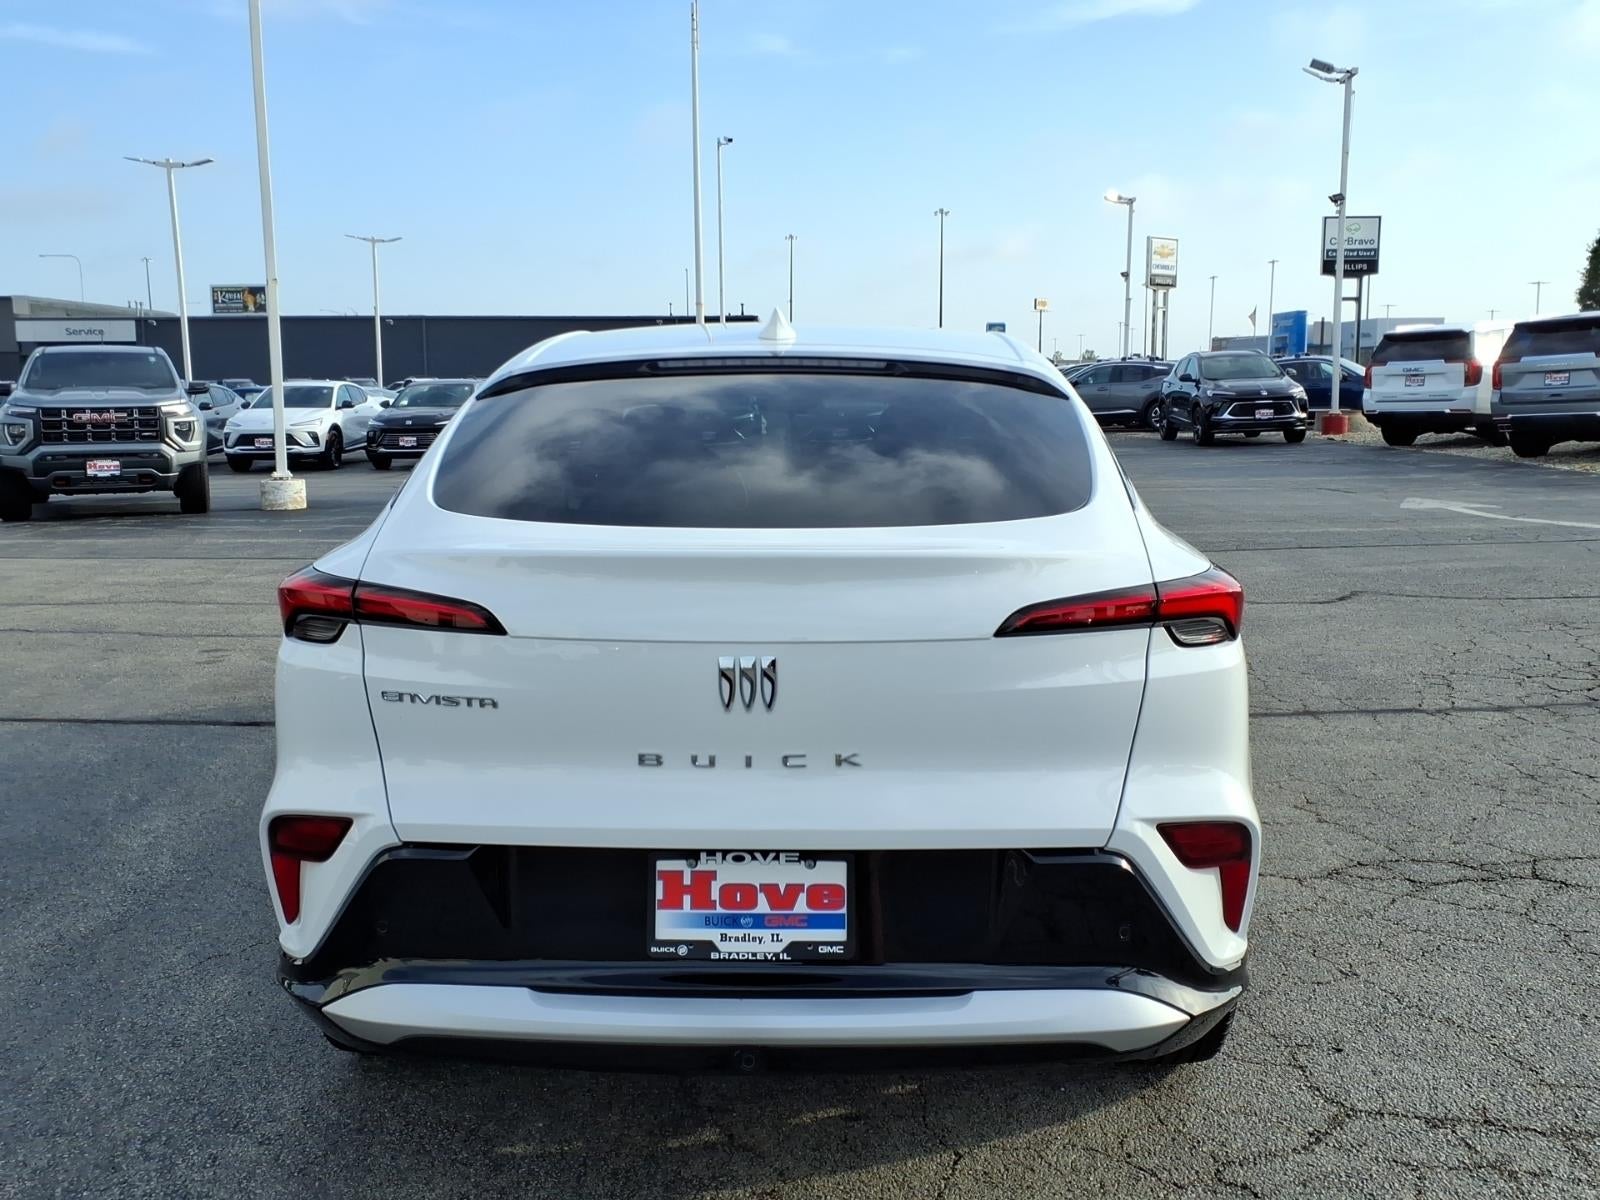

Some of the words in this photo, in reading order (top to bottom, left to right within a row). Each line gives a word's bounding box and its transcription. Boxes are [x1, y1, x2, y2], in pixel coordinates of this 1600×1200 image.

[1329, 236, 1375, 246] CBravo
[65, 327, 104, 336] Service
[73, 412, 128, 424] GMC
[87, 462, 120, 470] Hove
[381, 691, 499, 709] ENVISTA
[637, 753, 863, 768] BUICK
[700, 851, 801, 865] HOVE
[656, 869, 846, 911] Hove
[704, 915, 739, 927] BUICK
[764, 915, 808, 927] GMC
[719, 932, 767, 945] Bradley,
[770, 933, 783, 943] IL
[818, 945, 845, 953] GMC
[710, 951, 776, 961] BRADLEY,
[779, 951, 792, 961] IL
